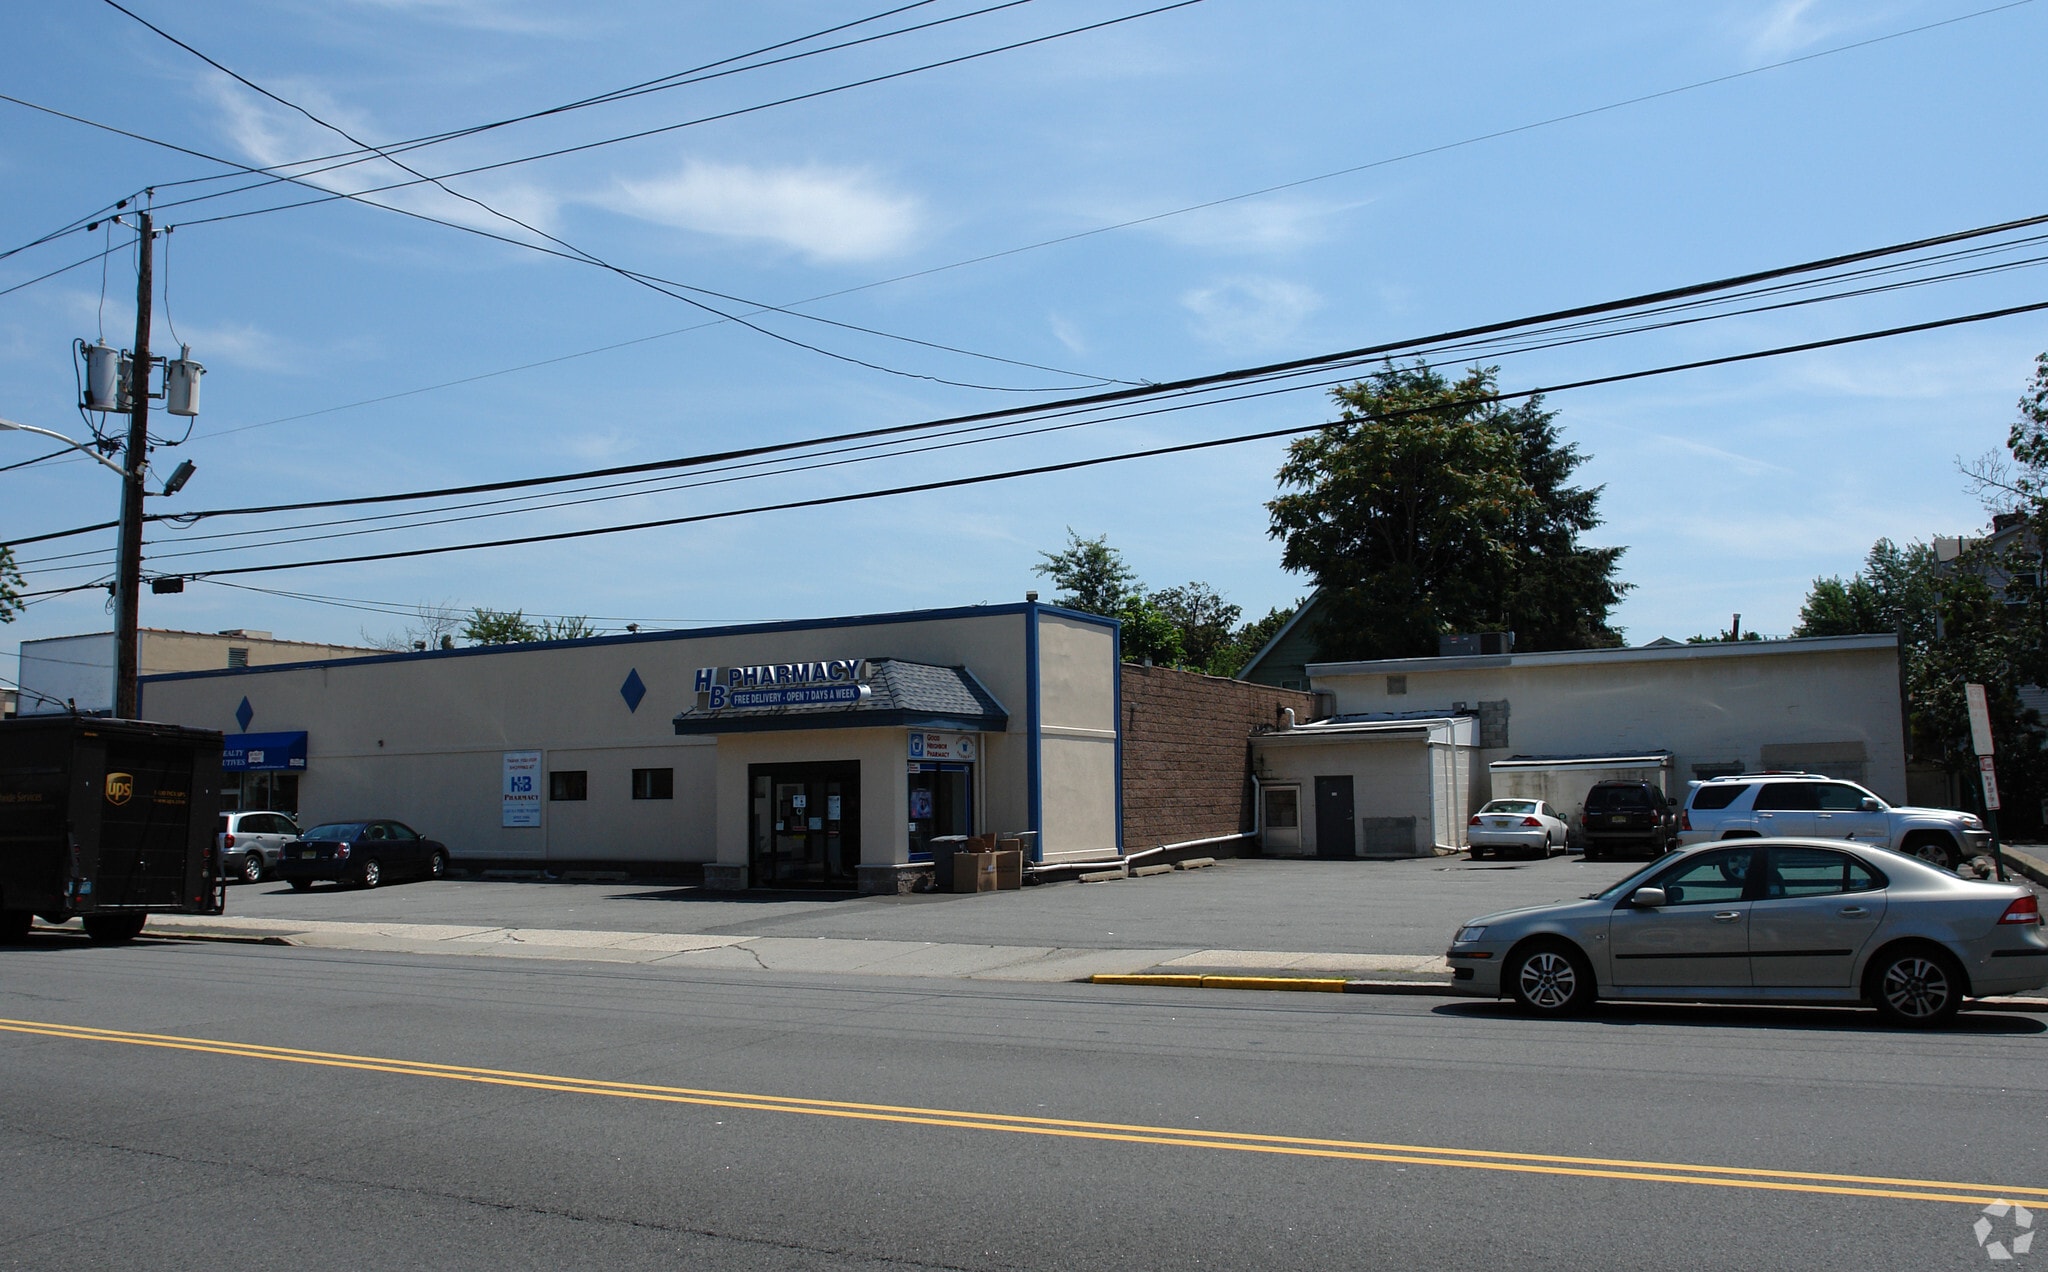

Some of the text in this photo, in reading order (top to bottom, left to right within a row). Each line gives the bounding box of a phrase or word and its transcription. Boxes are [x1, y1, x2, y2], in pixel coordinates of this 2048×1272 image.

[728, 659, 860, 687] PHARMACY
[734, 693, 749, 705] FREE
[751, 691, 781, 704] DELIVERY
[787, 689, 804, 701] OPEN
[806, 689, 810, 700] 7
[812, 688, 828, 700] DAYS
[830, 688, 835, 699] A
[836, 687, 855, 699] WEEK
